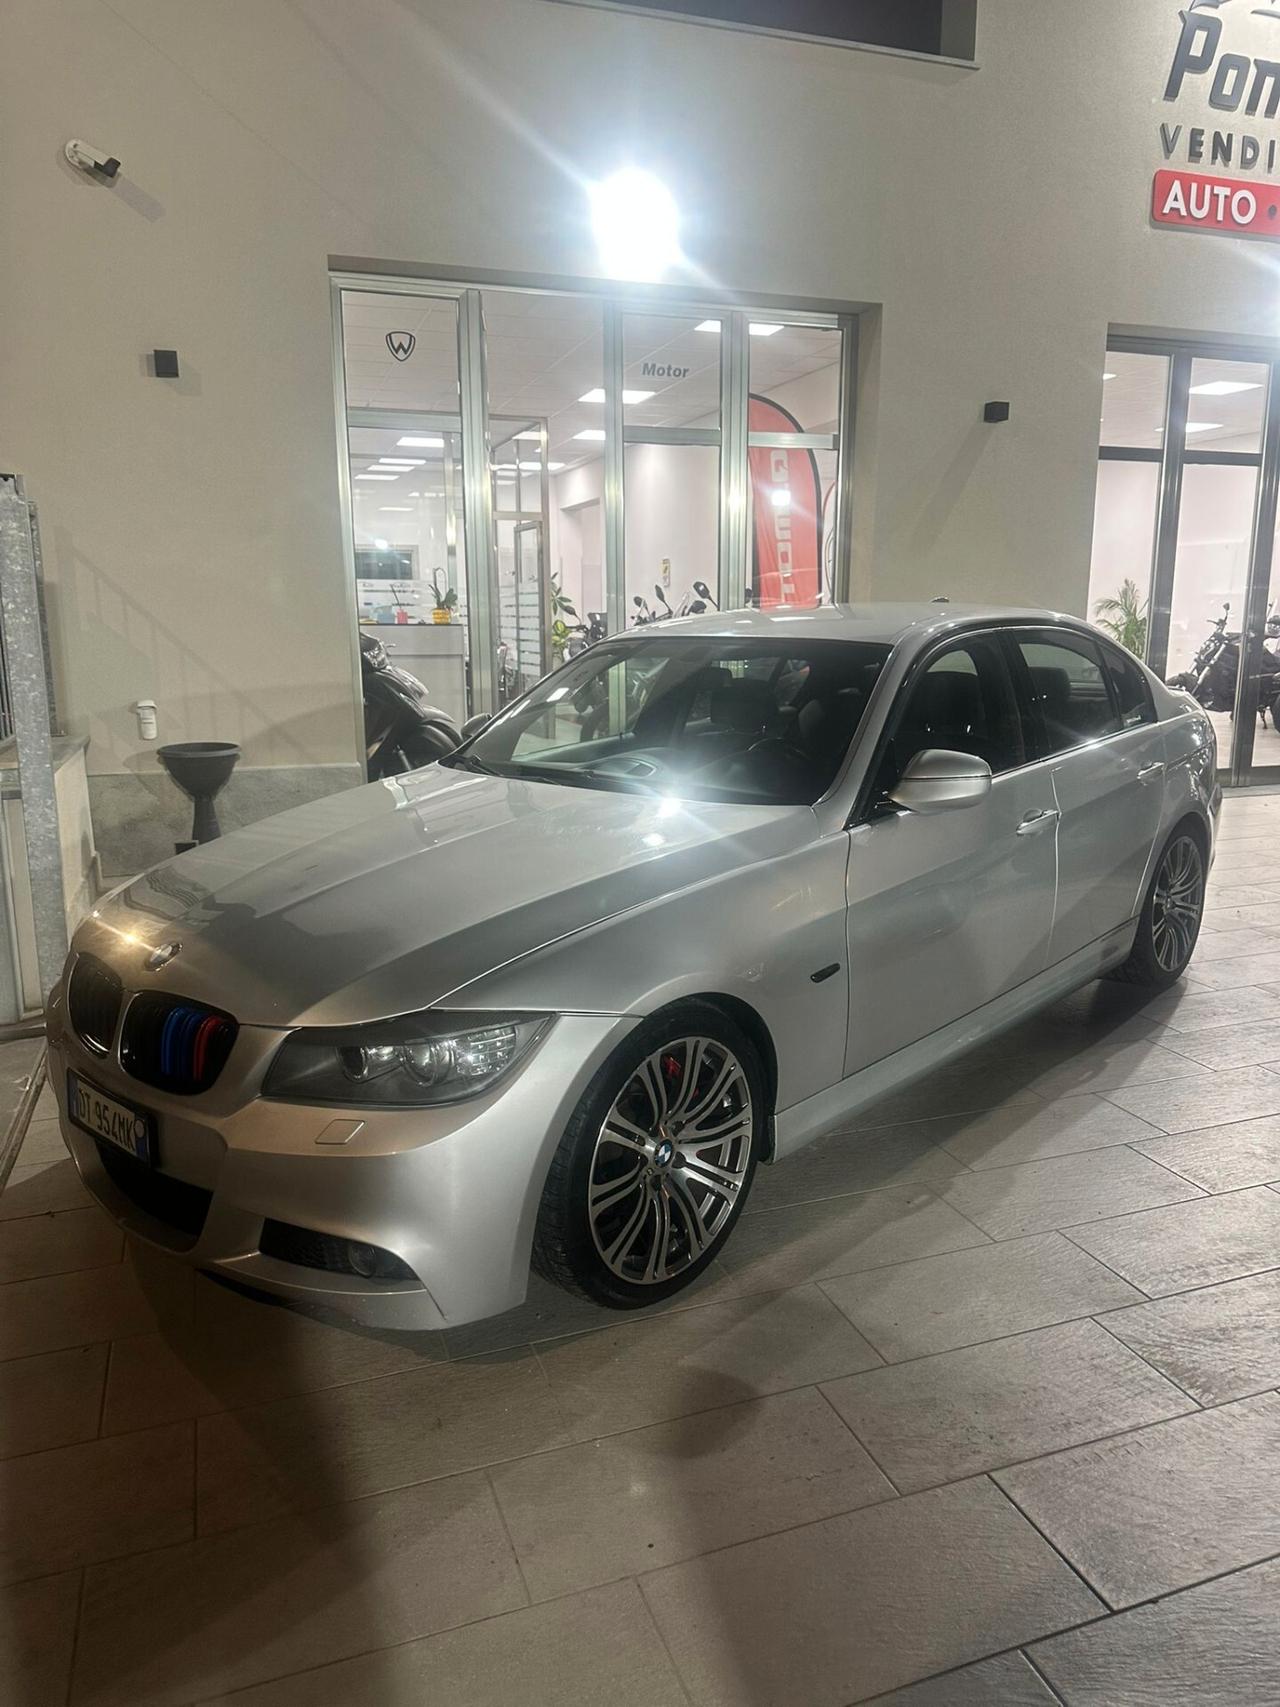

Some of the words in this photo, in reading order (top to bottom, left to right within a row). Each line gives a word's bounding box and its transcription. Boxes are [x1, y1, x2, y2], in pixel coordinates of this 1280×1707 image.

[1159, 122, 1276, 174] VENDI
[1162, 179, 1257, 225] AUTO
[642, 363, 689, 378] Motor
